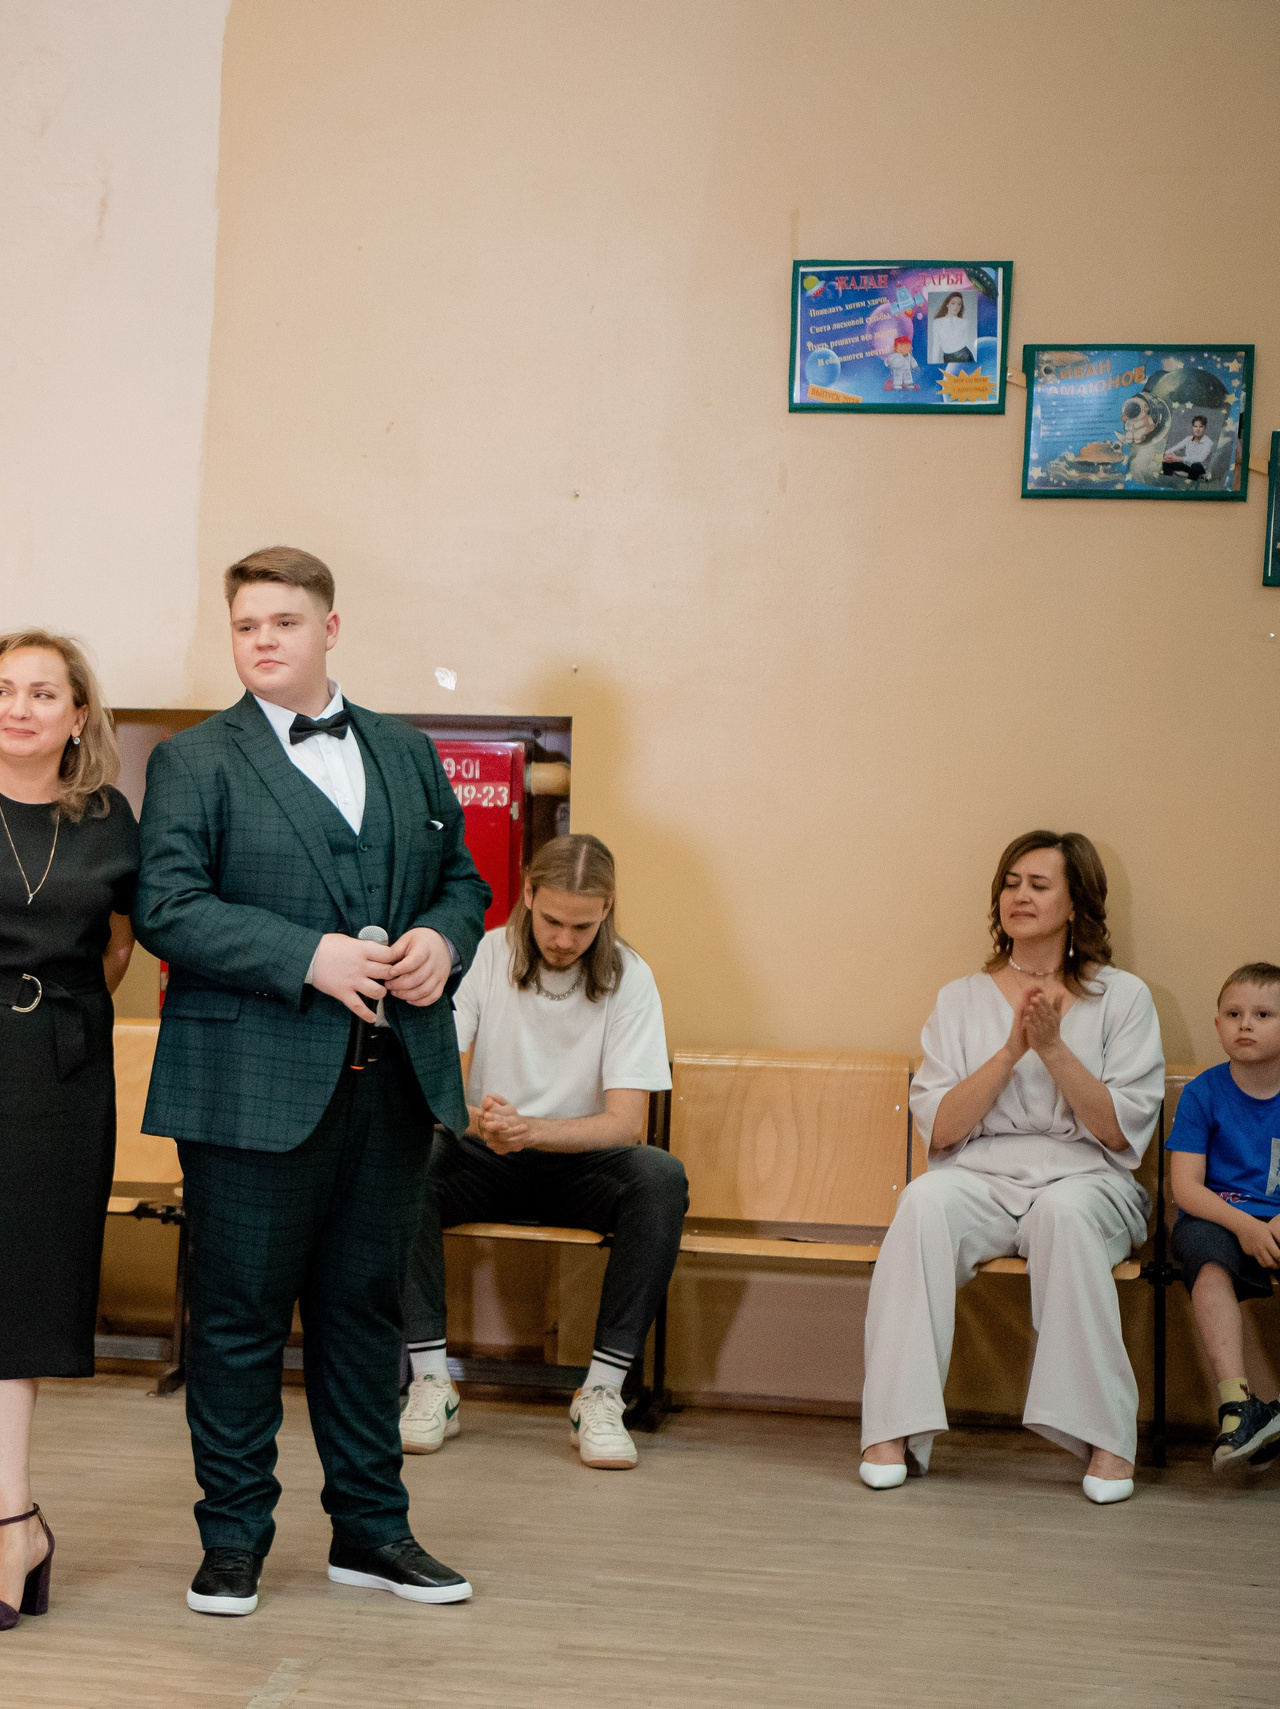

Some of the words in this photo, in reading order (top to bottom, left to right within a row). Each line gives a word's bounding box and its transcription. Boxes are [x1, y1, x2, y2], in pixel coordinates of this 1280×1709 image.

[835, 274, 888, 291] ЖАДАН
[1059, 359, 1111, 381] ИВАН
[810, 387, 841, 402] ВЫПУСК
